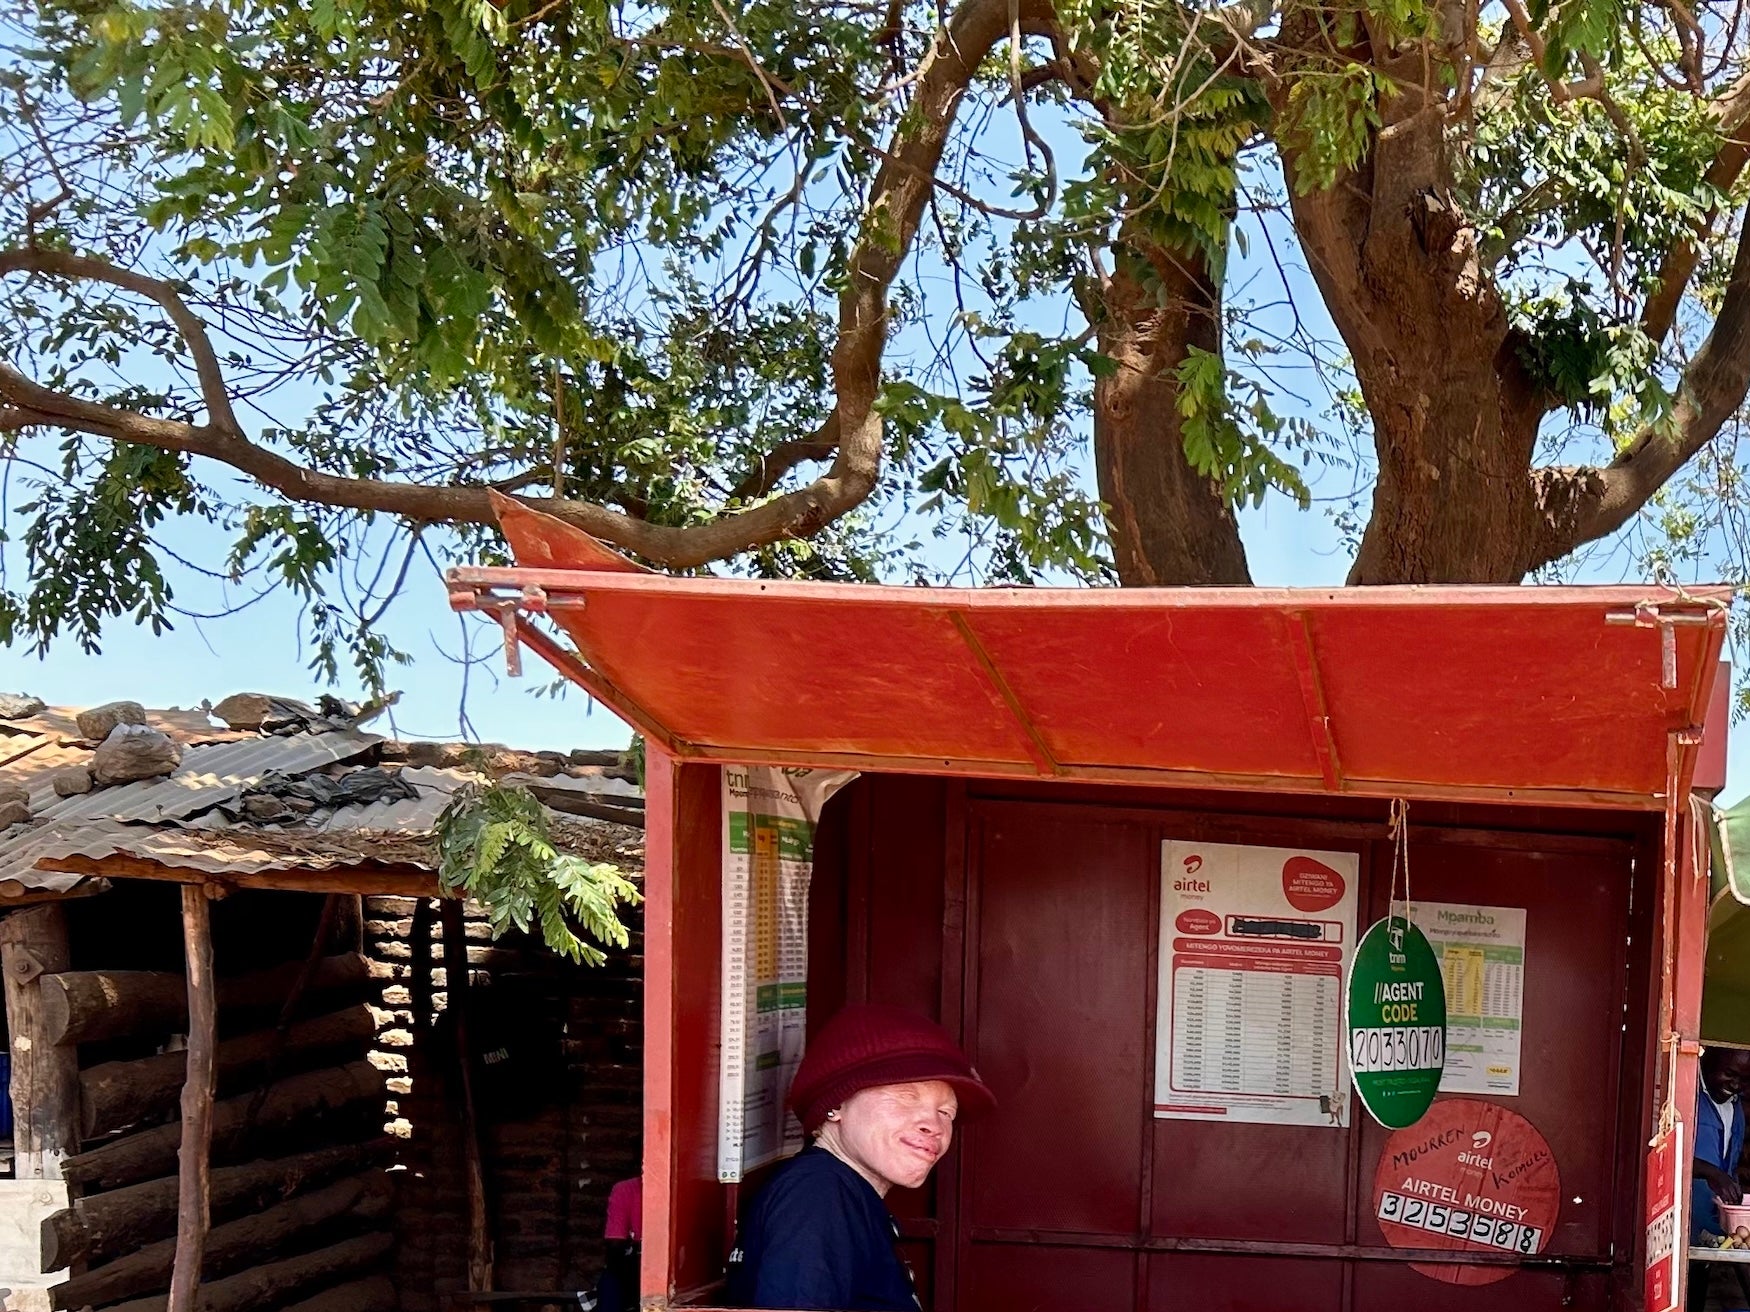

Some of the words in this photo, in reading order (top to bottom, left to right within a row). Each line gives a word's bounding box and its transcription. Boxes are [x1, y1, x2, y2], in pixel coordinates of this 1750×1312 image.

[1173, 876, 1212, 893] airtel
[1288, 885, 1313, 893] AIRTEL
[1313, 886, 1338, 896] MONEY
[1292, 879, 1325, 888] MITENGO
[1437, 909, 1495, 926] Mpamba
[1186, 942, 1218, 951] MITENGO
[1281, 948, 1304, 957] AIRTEL
[1304, 950, 1329, 958] MONEY
[1389, 952, 1407, 964] tnm
[1381, 1003, 1419, 1024] CODE
[1355, 1029, 1441, 1067] 2033070
[1457, 1150, 1493, 1170] airtel
[1401, 1177, 1461, 1205] AIRTEL
[1464, 1192, 1529, 1222] MONEY
[1383, 1194, 1535, 1254] 3253588
